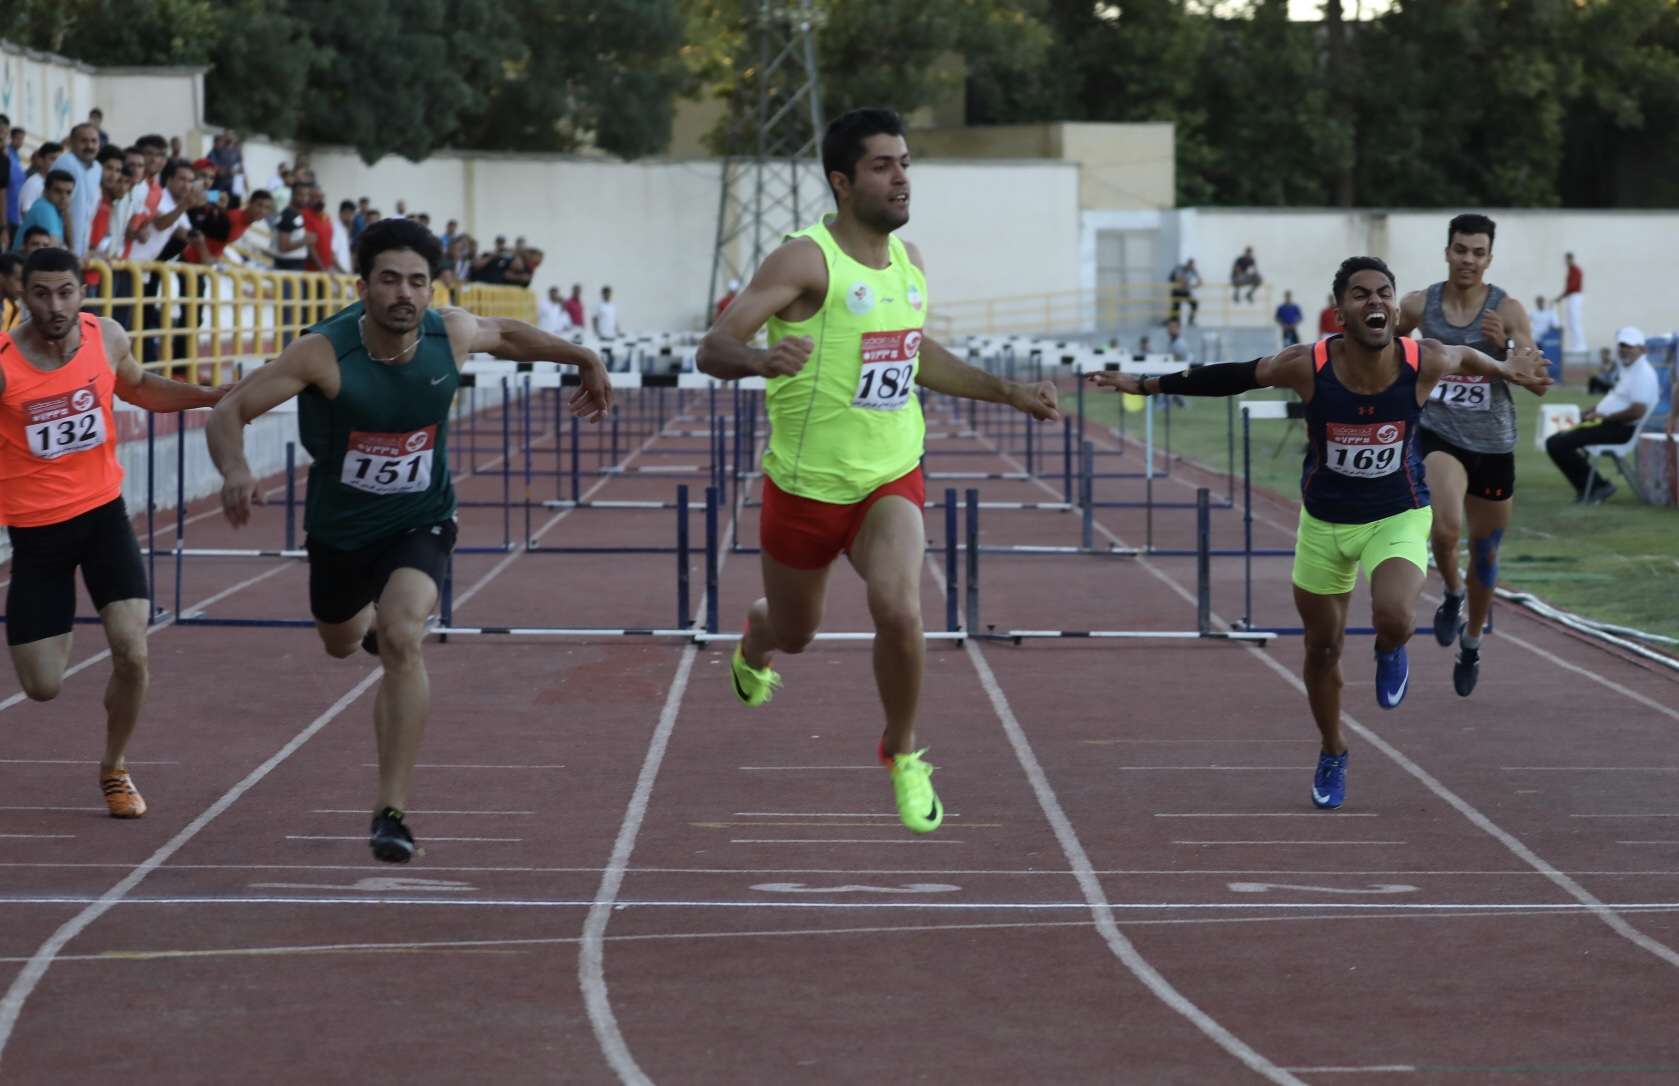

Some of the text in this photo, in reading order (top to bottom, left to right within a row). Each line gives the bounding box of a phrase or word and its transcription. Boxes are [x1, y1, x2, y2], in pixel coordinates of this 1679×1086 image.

[858, 364, 913, 399] 182
[1438, 383, 1484, 404] 128
[36, 414, 97, 451] 132
[354, 455, 422, 485] 151
[1335, 447, 1395, 470] 169
